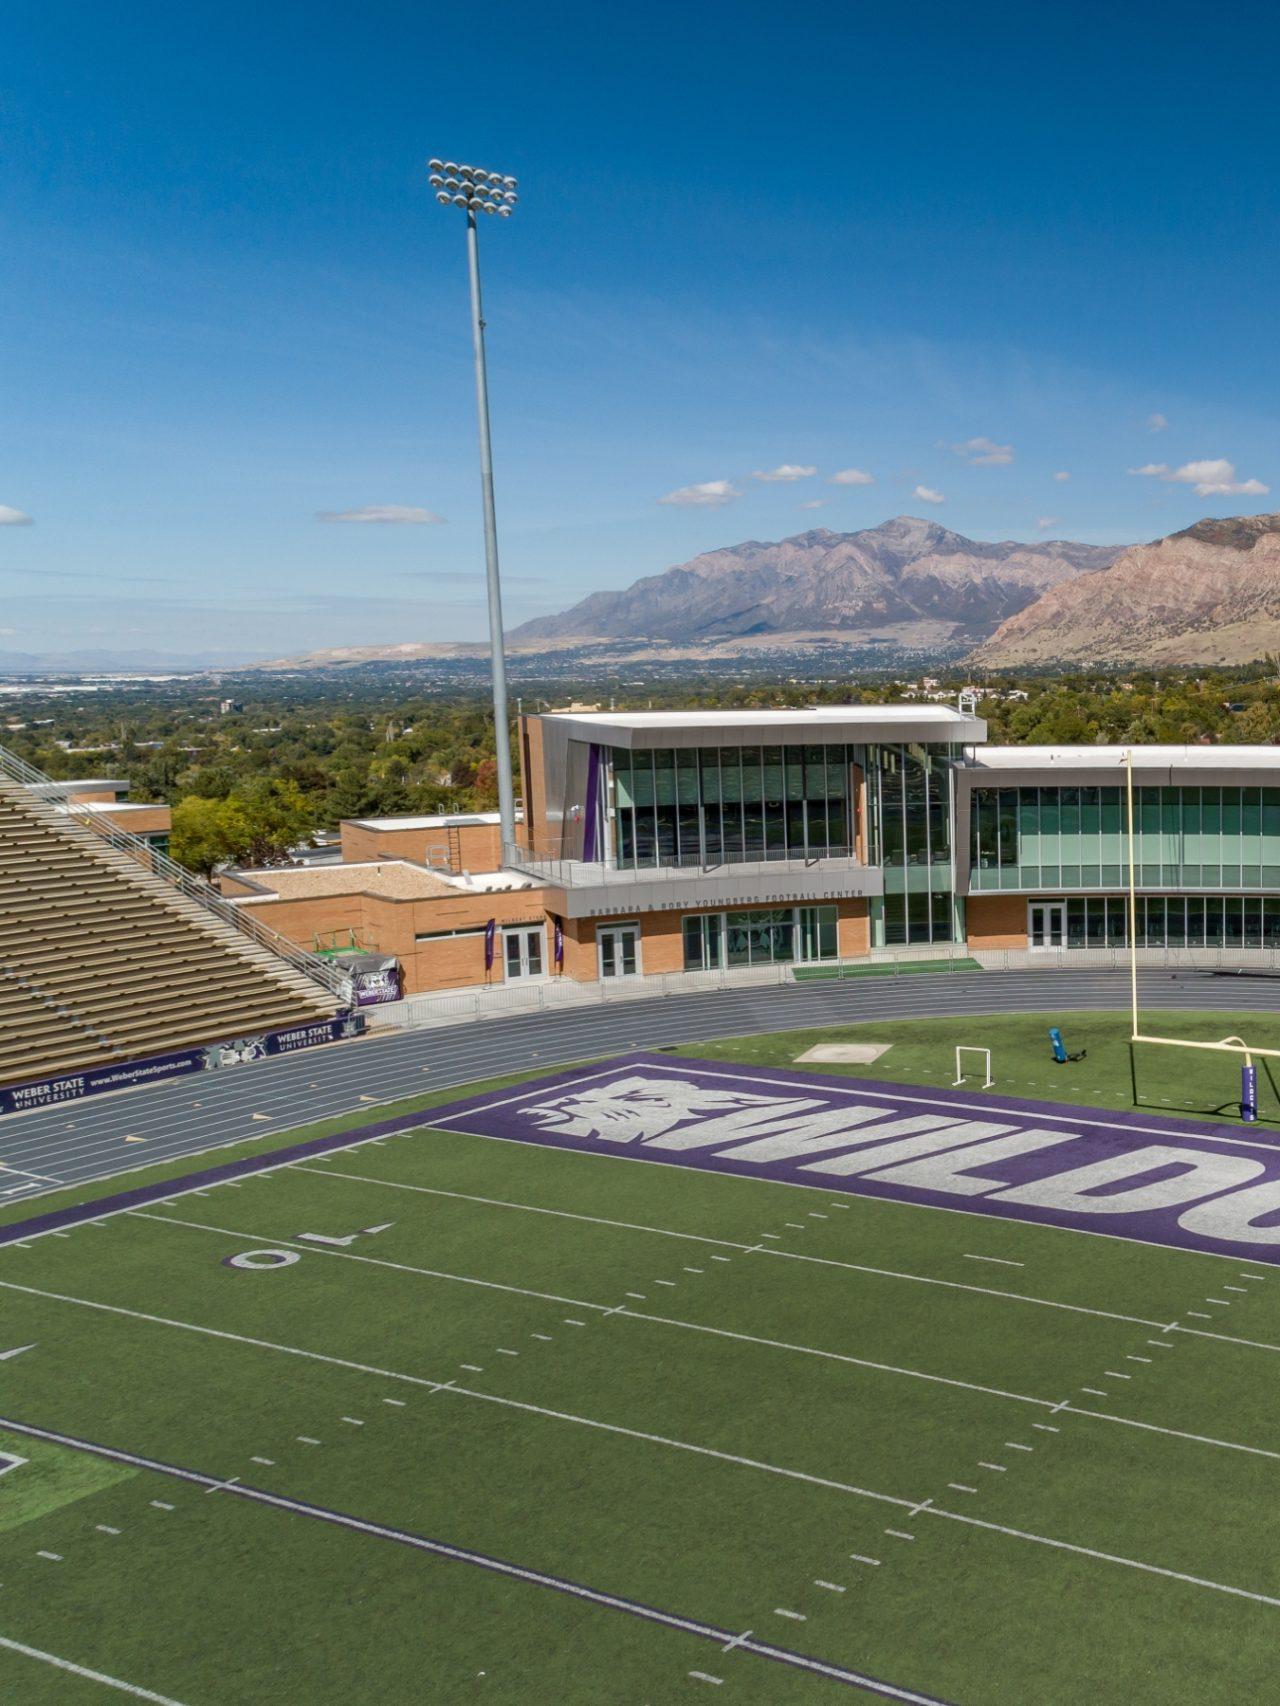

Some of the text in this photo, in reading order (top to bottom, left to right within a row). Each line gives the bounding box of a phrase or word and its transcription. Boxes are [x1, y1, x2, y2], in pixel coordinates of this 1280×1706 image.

[766, 893, 817, 904] FOOTBALL
[824, 889, 863, 899] CENTER
[359, 986, 396, 999] WEBER STATE
[277, 1031, 306, 1044] WEBER
[308, 1025, 332, 1037] STATE
[90, 1060, 192, 1086] www.WeberStateSports.com
[12, 1077, 84, 1100] WEBER STATE
[15, 1087, 85, 1109] UNIVERSITY
